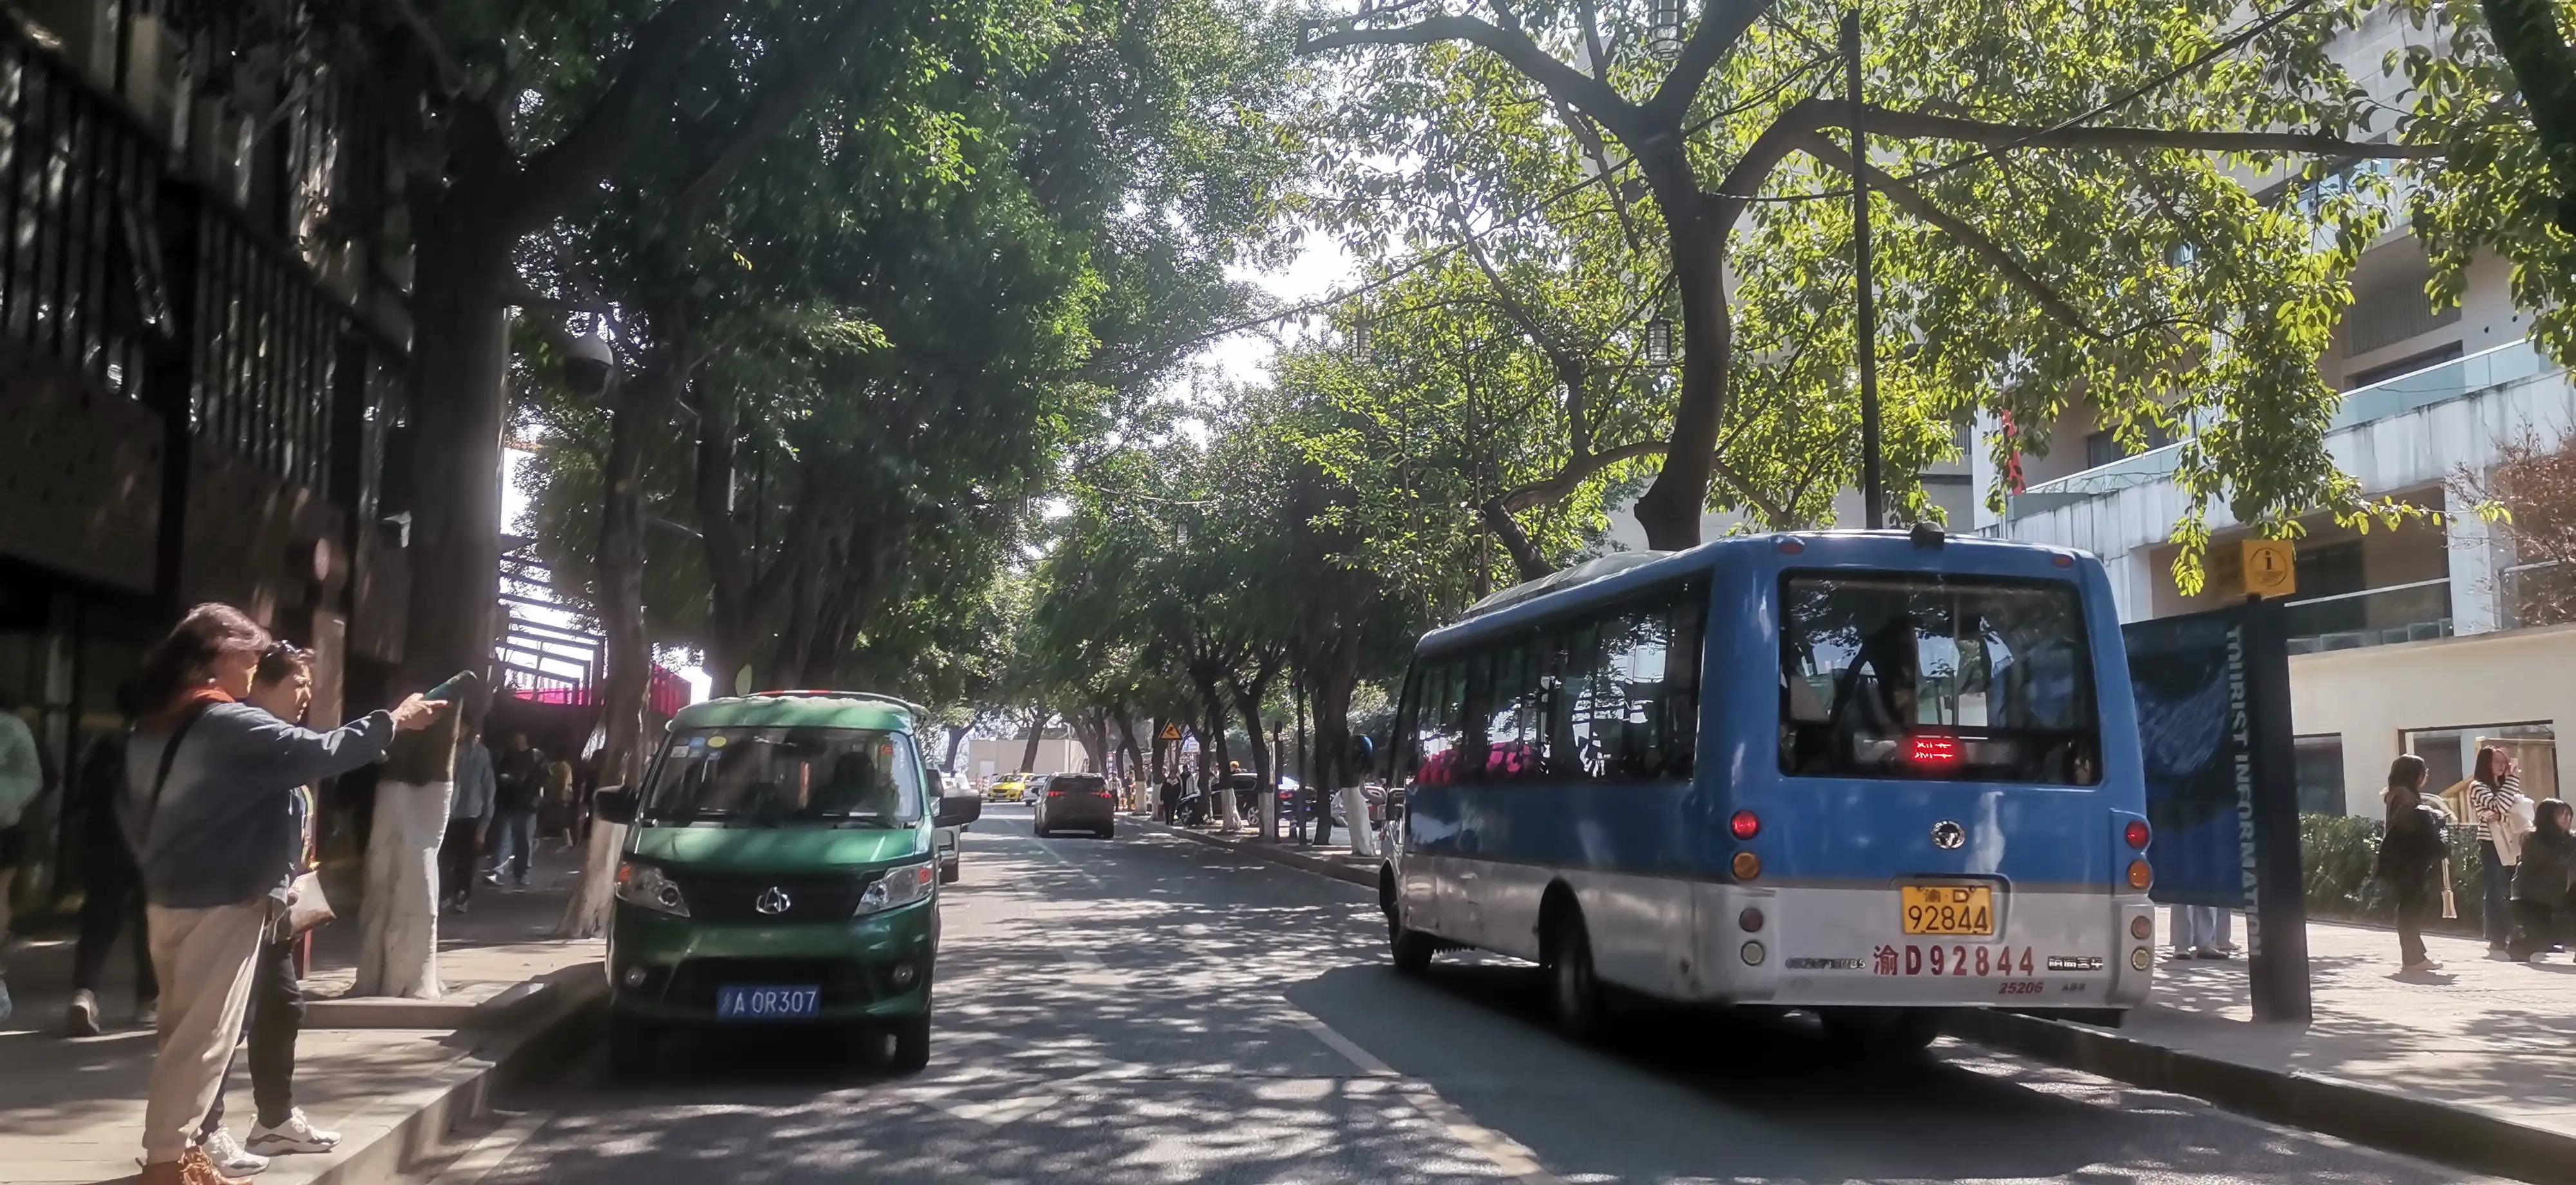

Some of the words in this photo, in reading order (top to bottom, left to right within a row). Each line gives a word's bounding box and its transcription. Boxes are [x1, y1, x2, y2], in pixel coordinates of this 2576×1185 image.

[2226, 625, 2248, 746] TOURIST
[2235, 754, 2261, 956] INFORMATION
[1908, 905, 1989, 931] 92844
[1873, 944, 2034, 976] 渝D92844
[1998, 981, 2044, 994] 25206
